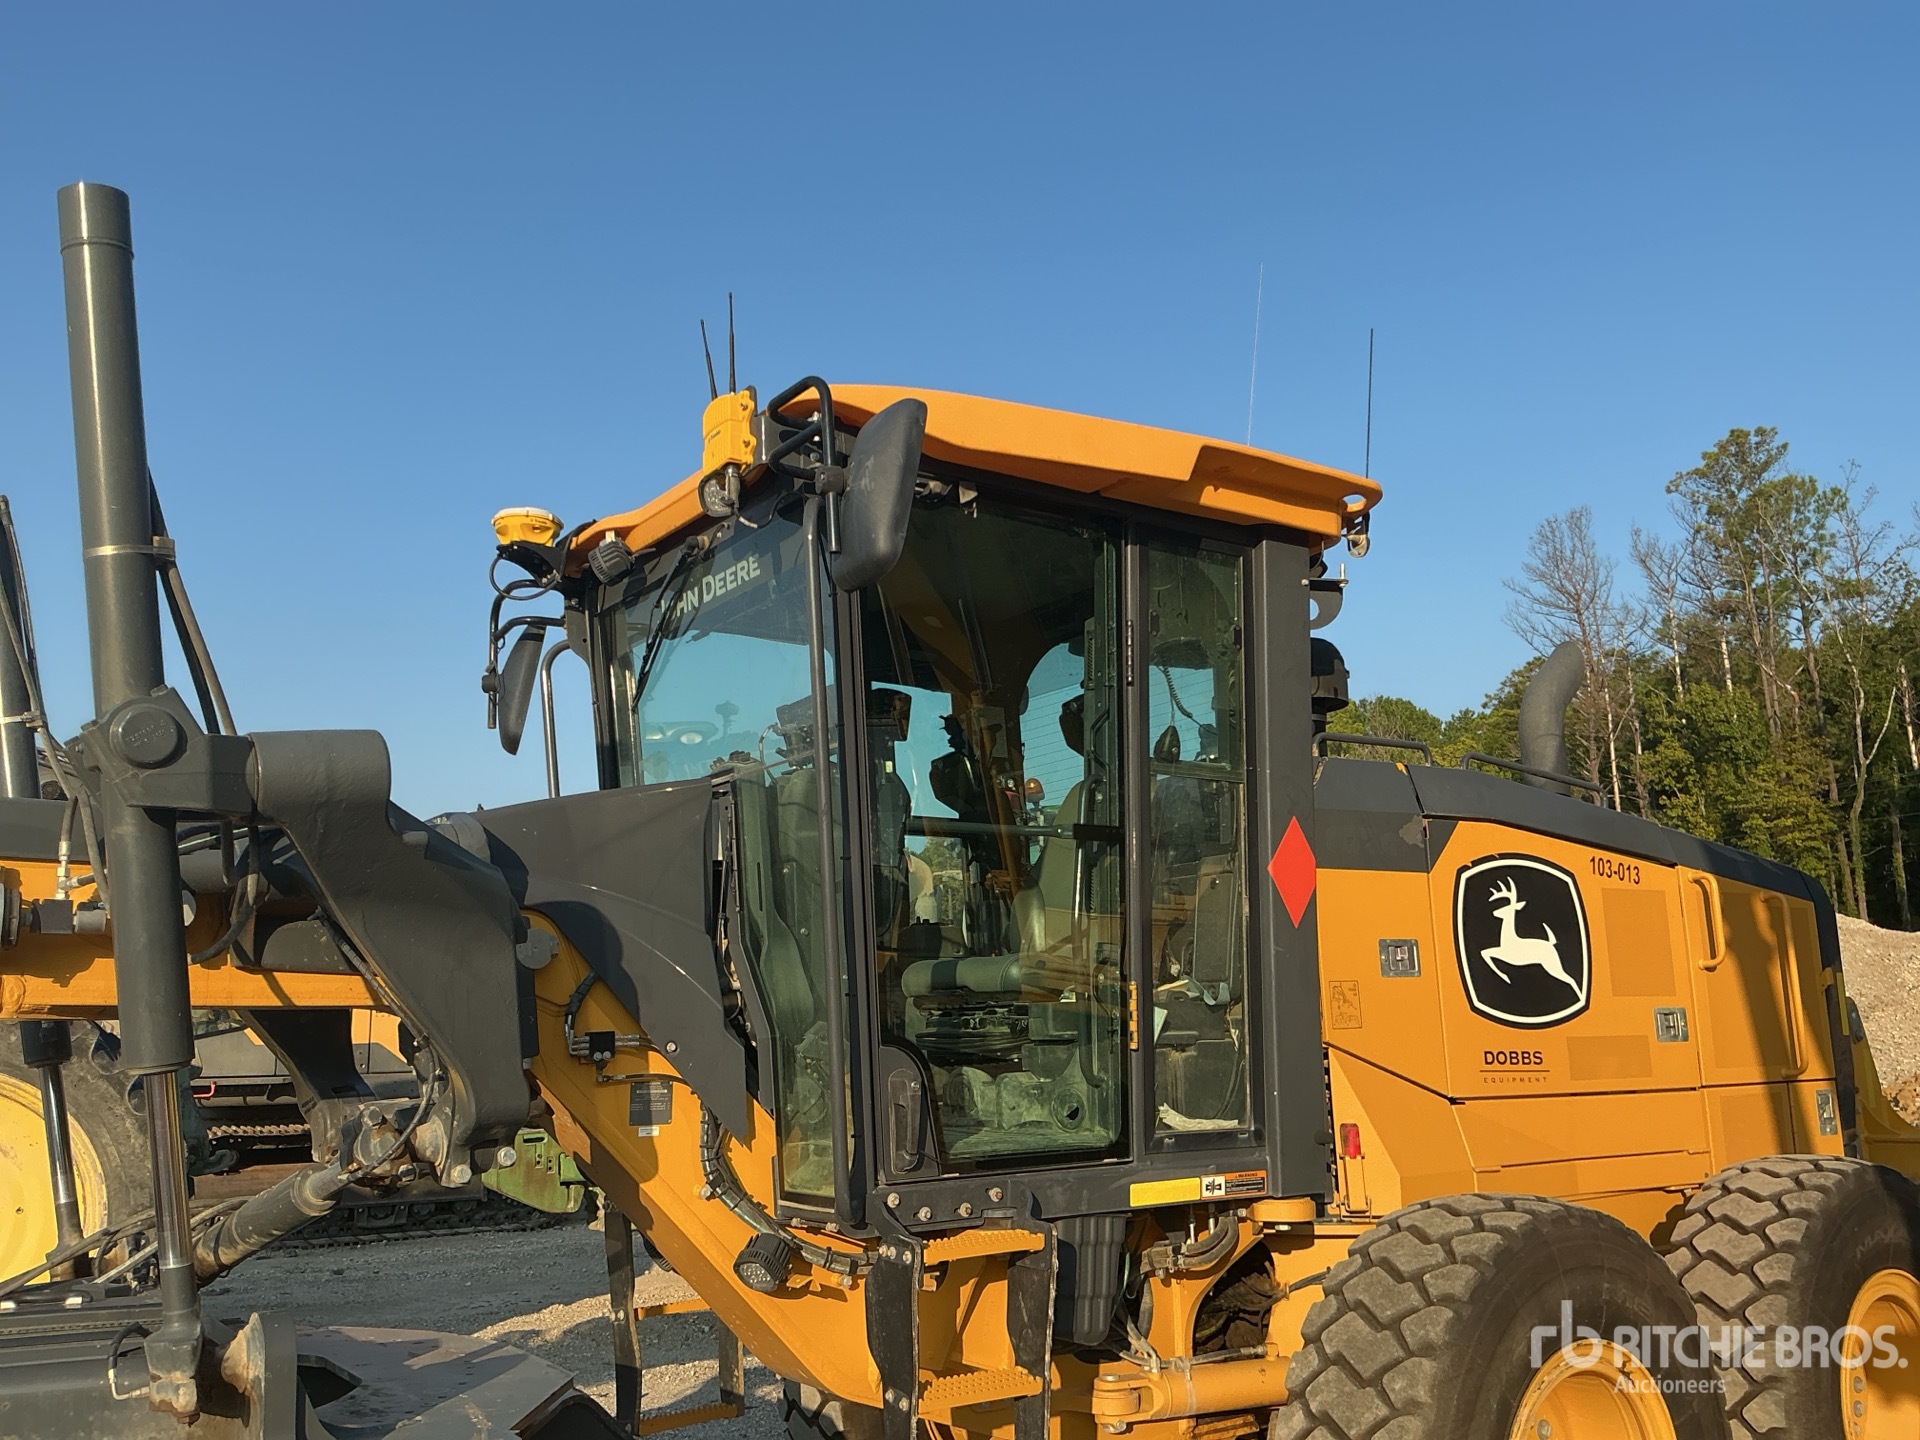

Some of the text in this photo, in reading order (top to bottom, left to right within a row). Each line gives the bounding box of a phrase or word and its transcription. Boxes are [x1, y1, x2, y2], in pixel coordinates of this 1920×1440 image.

[702, 556, 761, 603] DEERE
[1589, 855, 1641, 885] 103-013
[1483, 1050, 1544, 1066] DOBBS
[1483, 1076, 1547, 1084] EQUIPMENT
